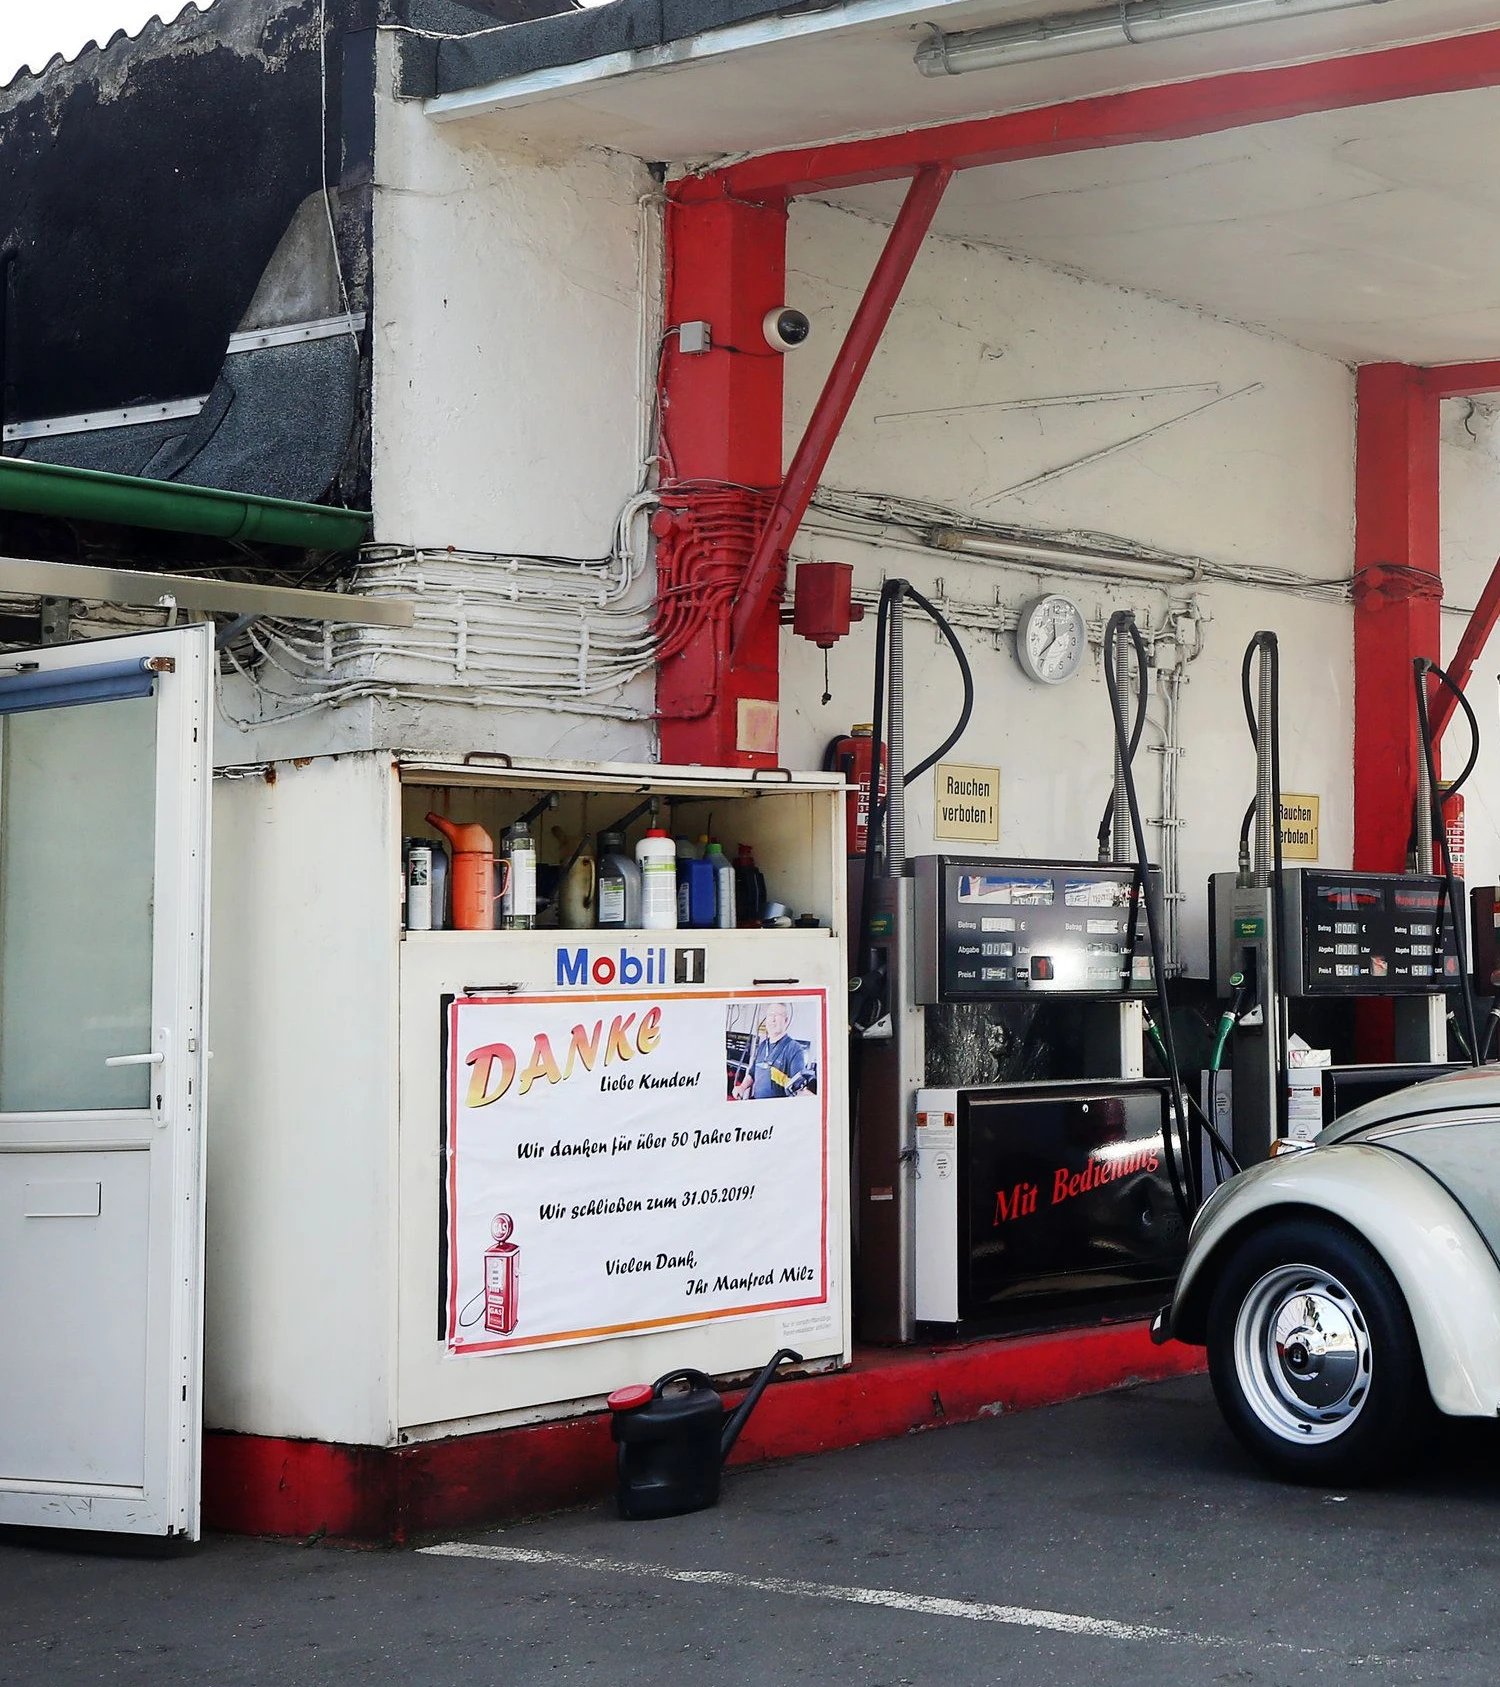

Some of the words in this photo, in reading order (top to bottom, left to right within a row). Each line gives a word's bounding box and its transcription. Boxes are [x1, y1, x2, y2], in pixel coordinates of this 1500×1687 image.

[947, 776, 990, 797] Rauchen
[942, 804, 986, 824] verboten
[1280, 828, 1308, 844] erboten
[557, 948, 665, 985] Mobil
[683, 950, 694, 982] 1
[465, 1006, 661, 1108] DANKE
[600, 1076, 634, 1092] Liebe
[639, 1072, 701, 1090] Kunden!
[517, 1143, 544, 1159] Wir
[550, 1139, 607, 1158] danken
[611, 1135, 632, 1156] für
[636, 1134, 667, 1150] über
[671, 1132, 689, 1148] 50
[693, 1130, 732, 1148] Jahre
[734, 1126, 774, 1143] Treue!
[993, 1182, 1039, 1227] Mit
[1051, 1148, 1158, 1205] Bedienung
[539, 1203, 566, 1220] Wir
[571, 1197, 642, 1220] schließen
[646, 1195, 677, 1211] zum
[682, 1185, 756, 1208] 31.05.2019!
[606, 1258, 651, 1276] Vielen
[656, 1250, 698, 1270] Dank,
[685, 1279, 709, 1296] Ihr
[712, 1268, 774, 1292] Manfred
[779, 1266, 814, 1283] Milz
[490, 1306, 502, 1316] GAS
